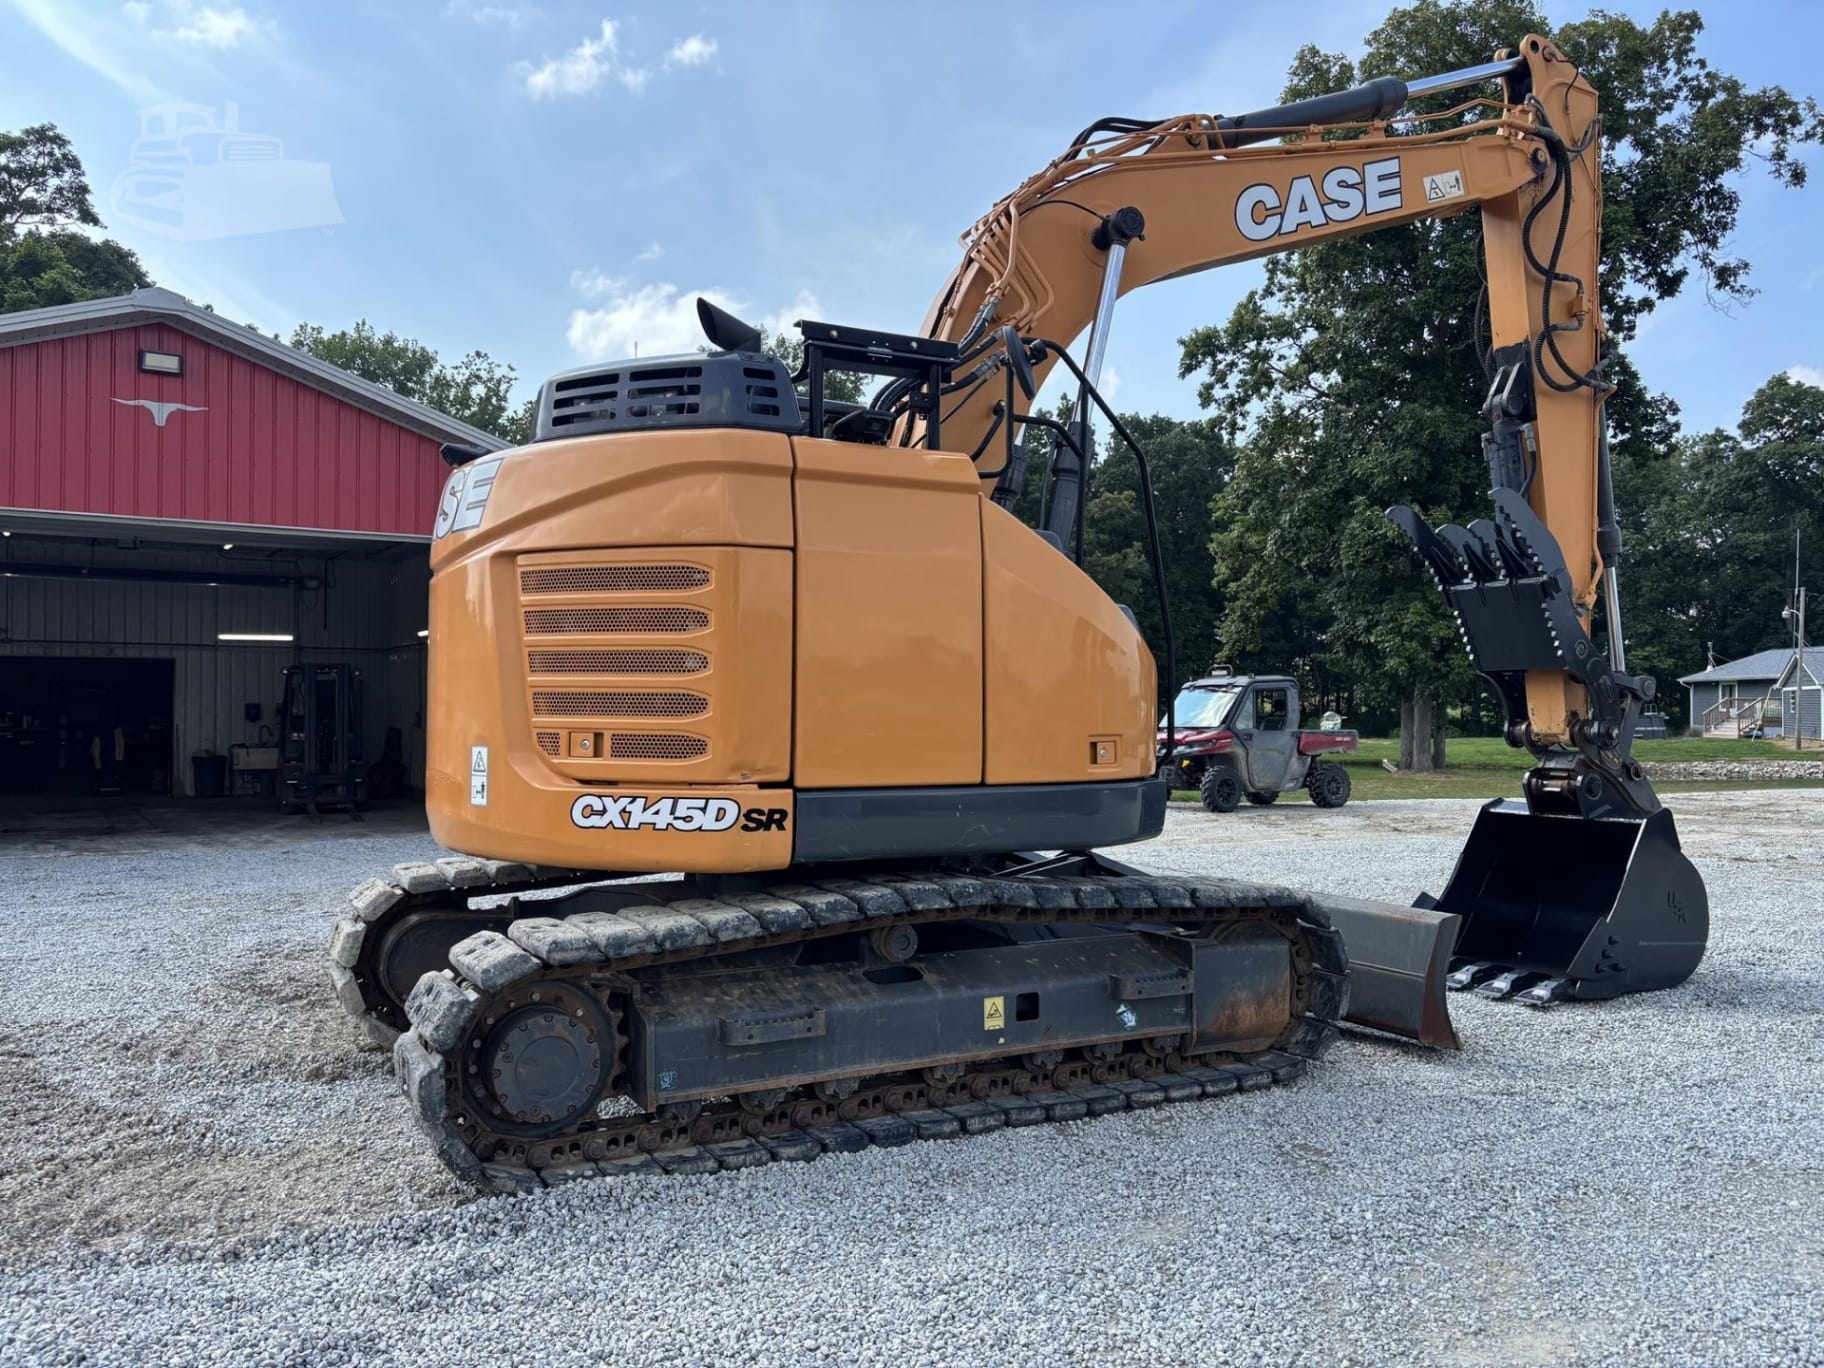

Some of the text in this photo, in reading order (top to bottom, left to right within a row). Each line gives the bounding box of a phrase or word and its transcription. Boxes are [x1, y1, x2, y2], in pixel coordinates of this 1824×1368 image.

[1235, 156, 1402, 242] CASE
[570, 794, 788, 831] CX145D SR
